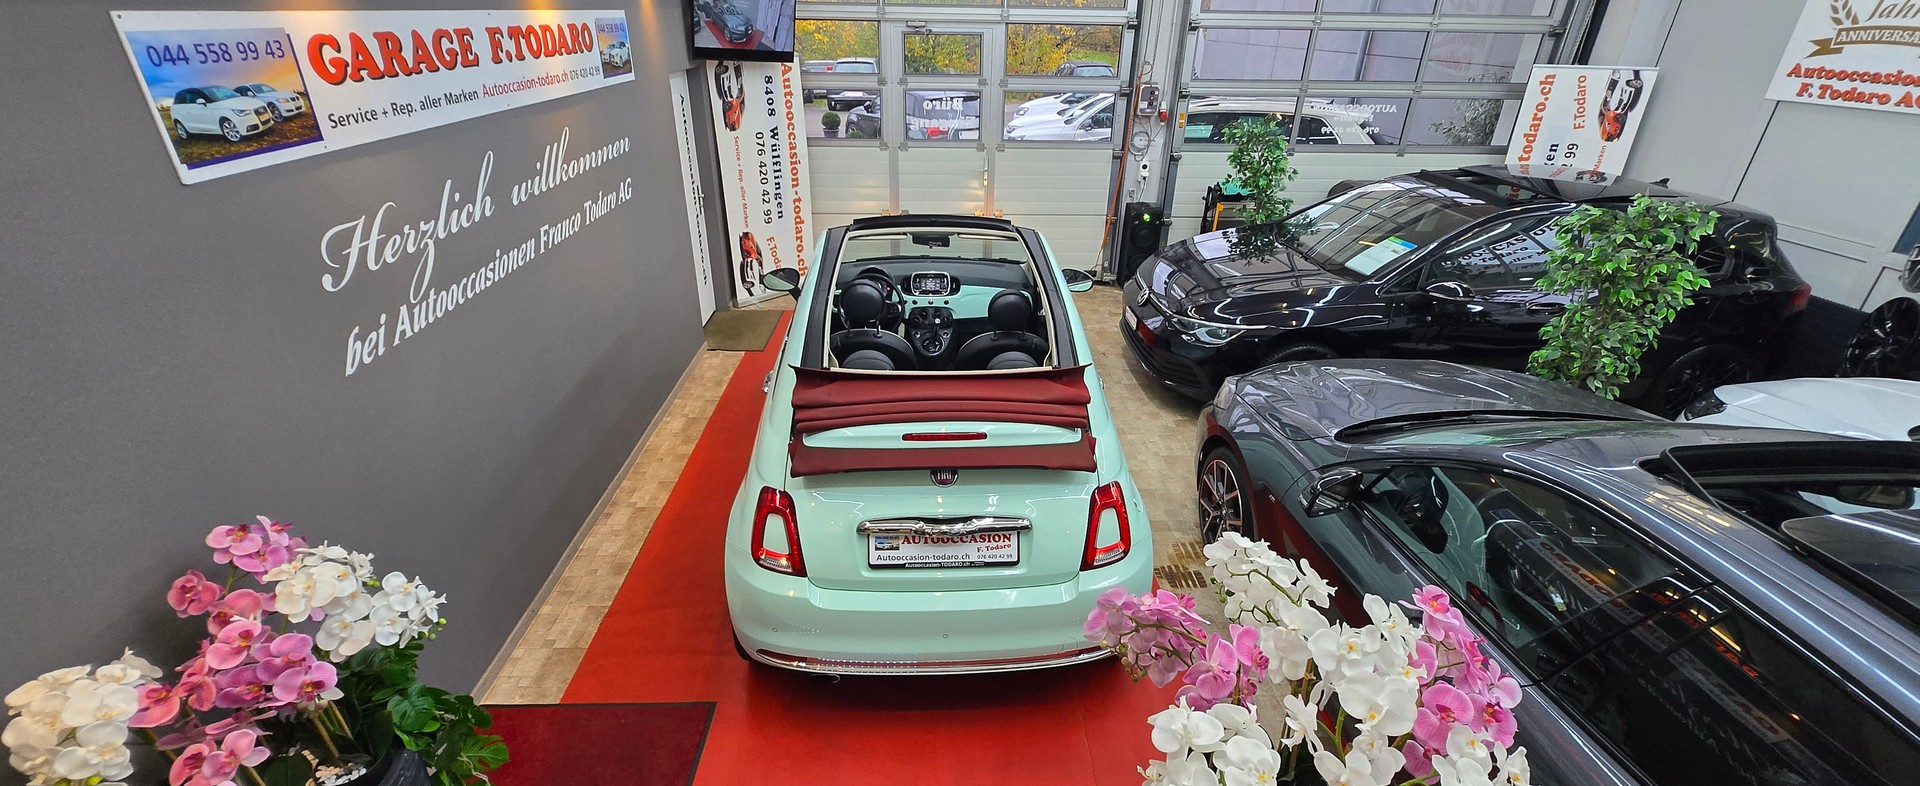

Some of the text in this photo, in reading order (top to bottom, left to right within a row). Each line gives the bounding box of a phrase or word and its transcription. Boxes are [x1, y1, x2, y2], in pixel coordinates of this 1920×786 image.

[146, 40, 285, 67] 044 558 99 43
[307, 22, 594, 85] GARAGE F.TODARO
[328, 66, 601, 129] Service + Rep. aller Marken Autooccasion-todaro.ch 076 420 42 99
[1573, 74, 1588, 131] F.Todaro
[1796, 82, 1813, 98] F.
[1817, 84, 1892, 105] Todaro
[733, 136, 741, 161] Service
[764, 75, 784, 220] 8408 Wülflingen
[781, 63, 809, 278] Autooccasion-todaro.ch
[1564, 142, 1579, 159] 99
[755, 131, 773, 225] 076 420 42 99
[320, 126, 630, 304] Herzlich willkommen
[345, 177, 632, 377] bei Autooccasionen Franco Todaro AG
[876, 553, 971, 562] Autooccasion-todaro.ch
[985, 543, 1012, 552] Todaro
